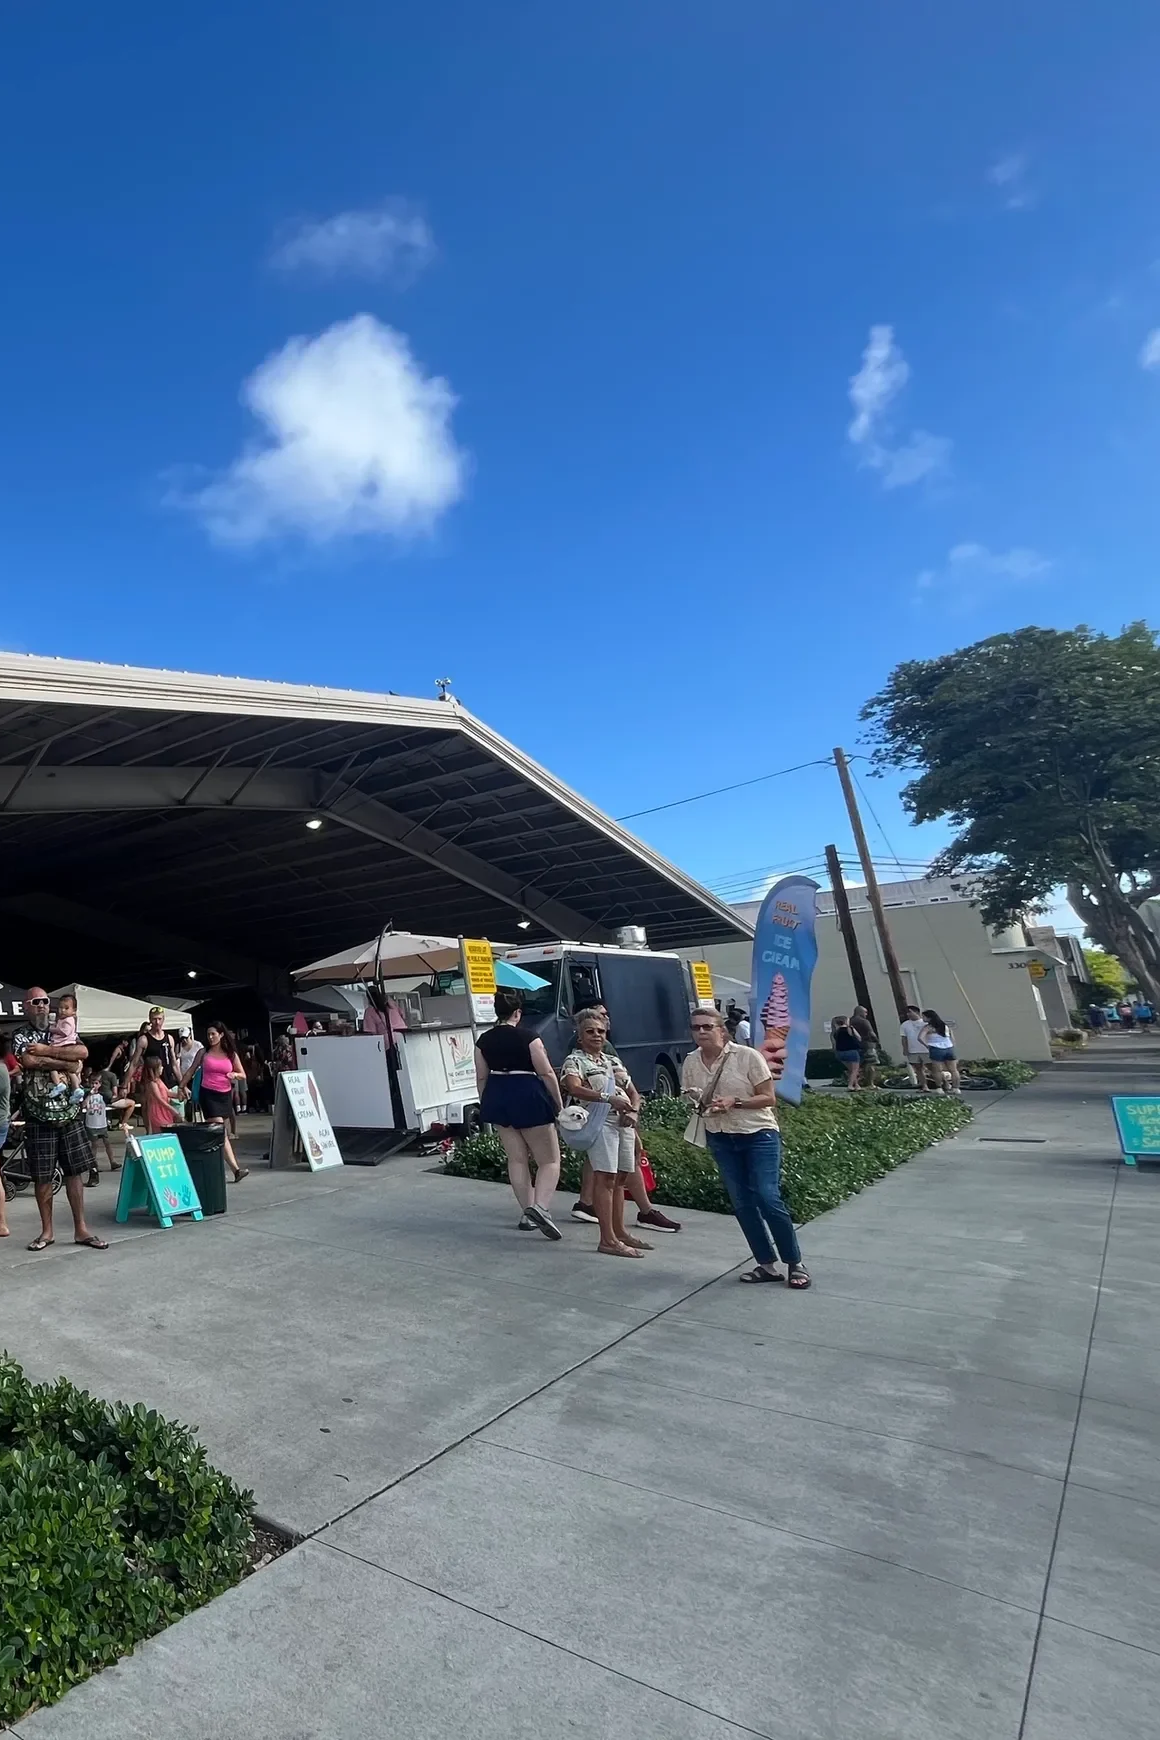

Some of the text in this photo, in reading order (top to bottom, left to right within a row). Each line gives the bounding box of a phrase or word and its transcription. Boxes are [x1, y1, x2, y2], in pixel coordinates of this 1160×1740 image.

[291, 1086, 305, 1095] FRUIT
[297, 1110, 315, 1120] CREAM
[146, 1146, 176, 1163] PUMP
[157, 1163, 178, 1178] IT!
